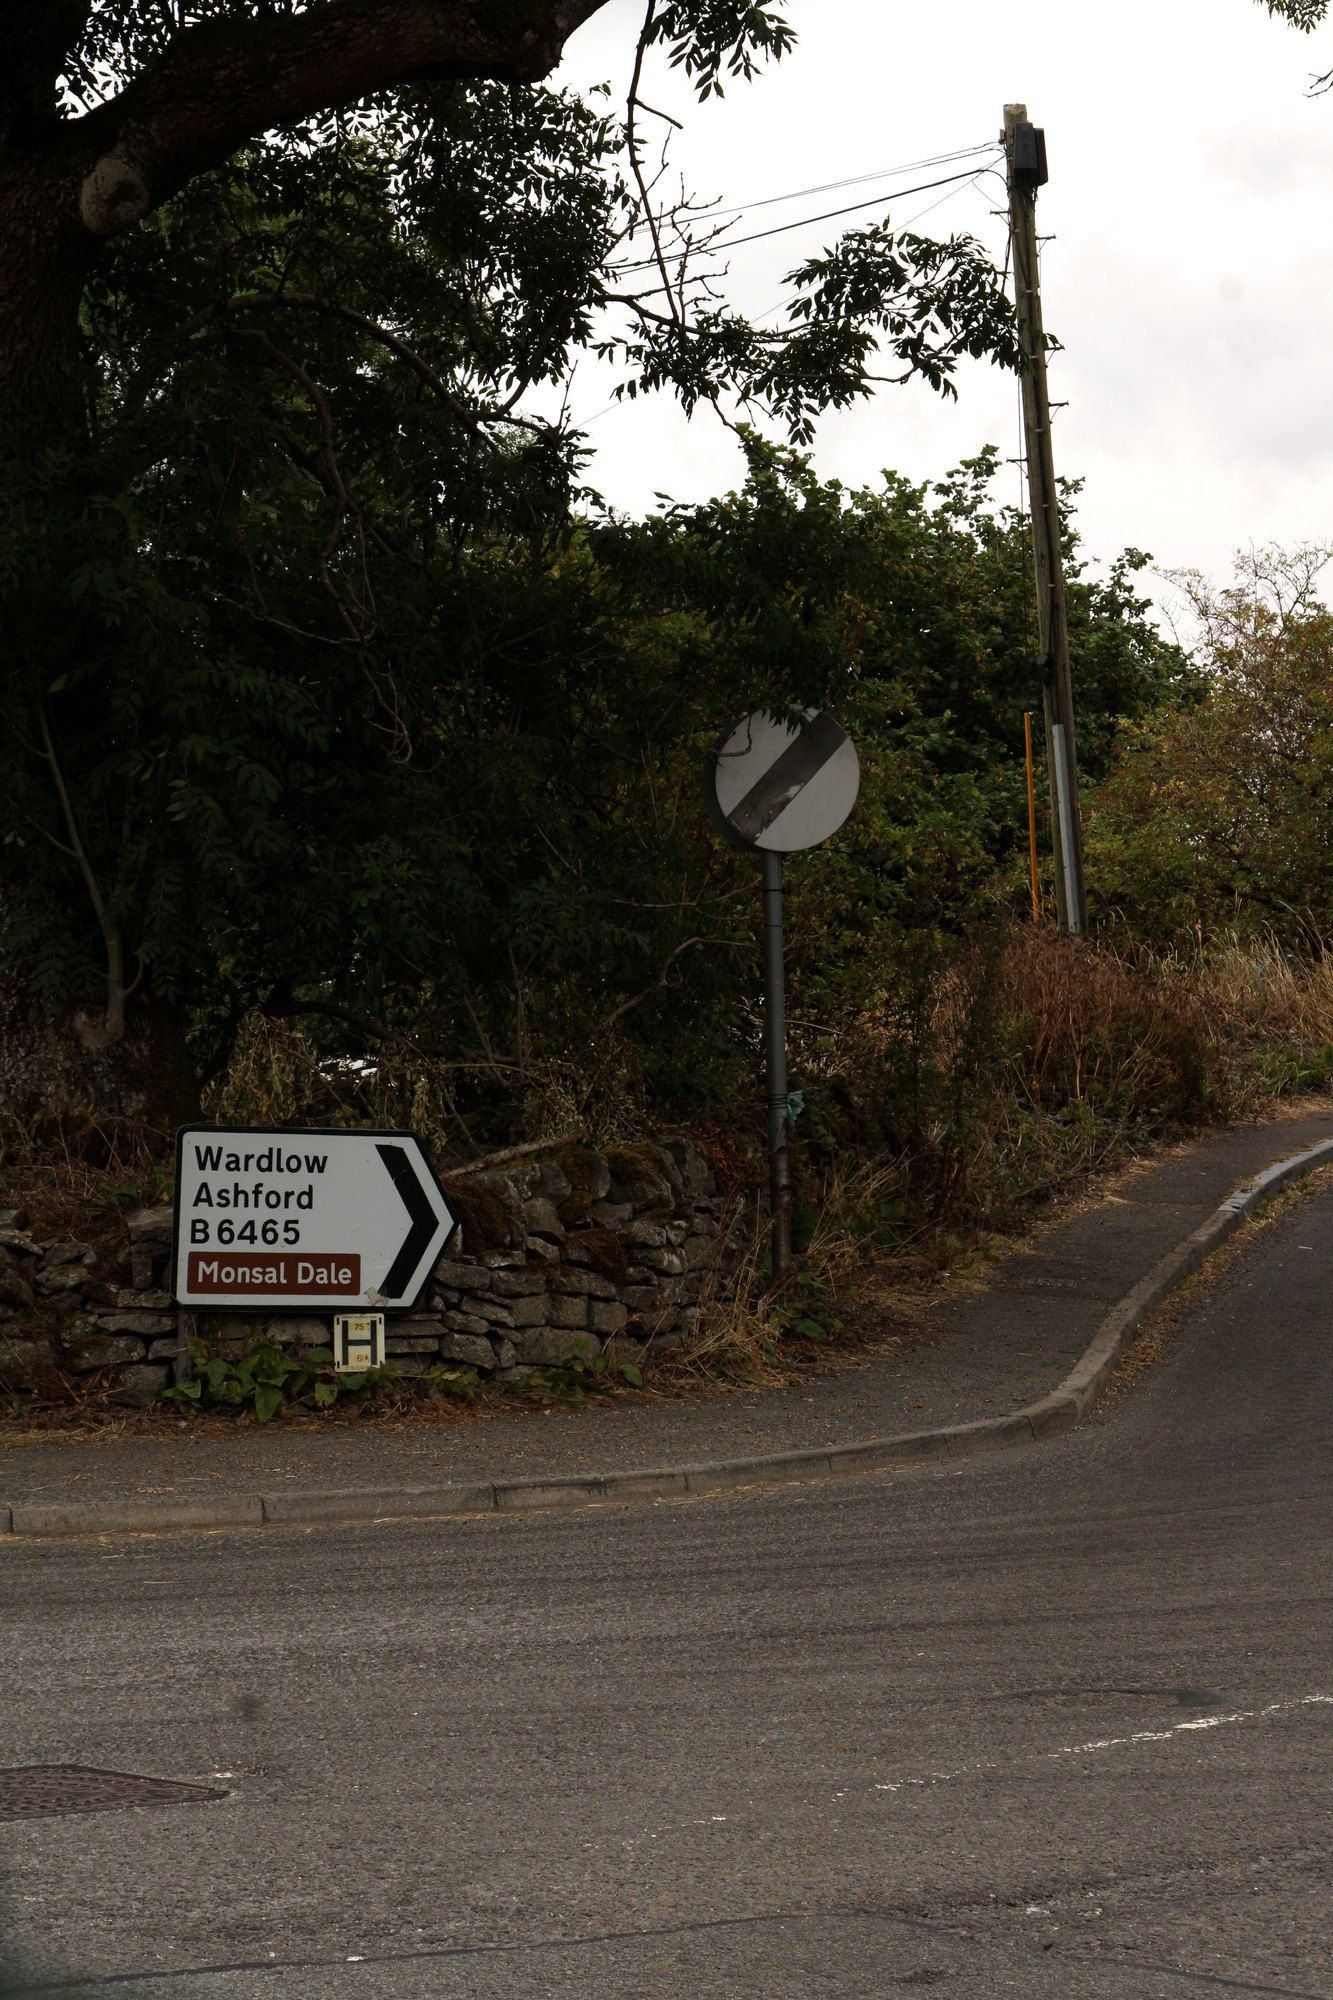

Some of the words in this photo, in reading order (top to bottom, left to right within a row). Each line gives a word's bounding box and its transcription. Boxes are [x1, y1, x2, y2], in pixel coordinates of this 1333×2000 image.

[194, 1145, 328, 1173] Wardlow
[192, 1182, 314, 1209] Ashford
[197, 1261, 287, 1284] Monsal
[297, 1262, 352, 1285] Dale
[342, 1320, 377, 1365] H
